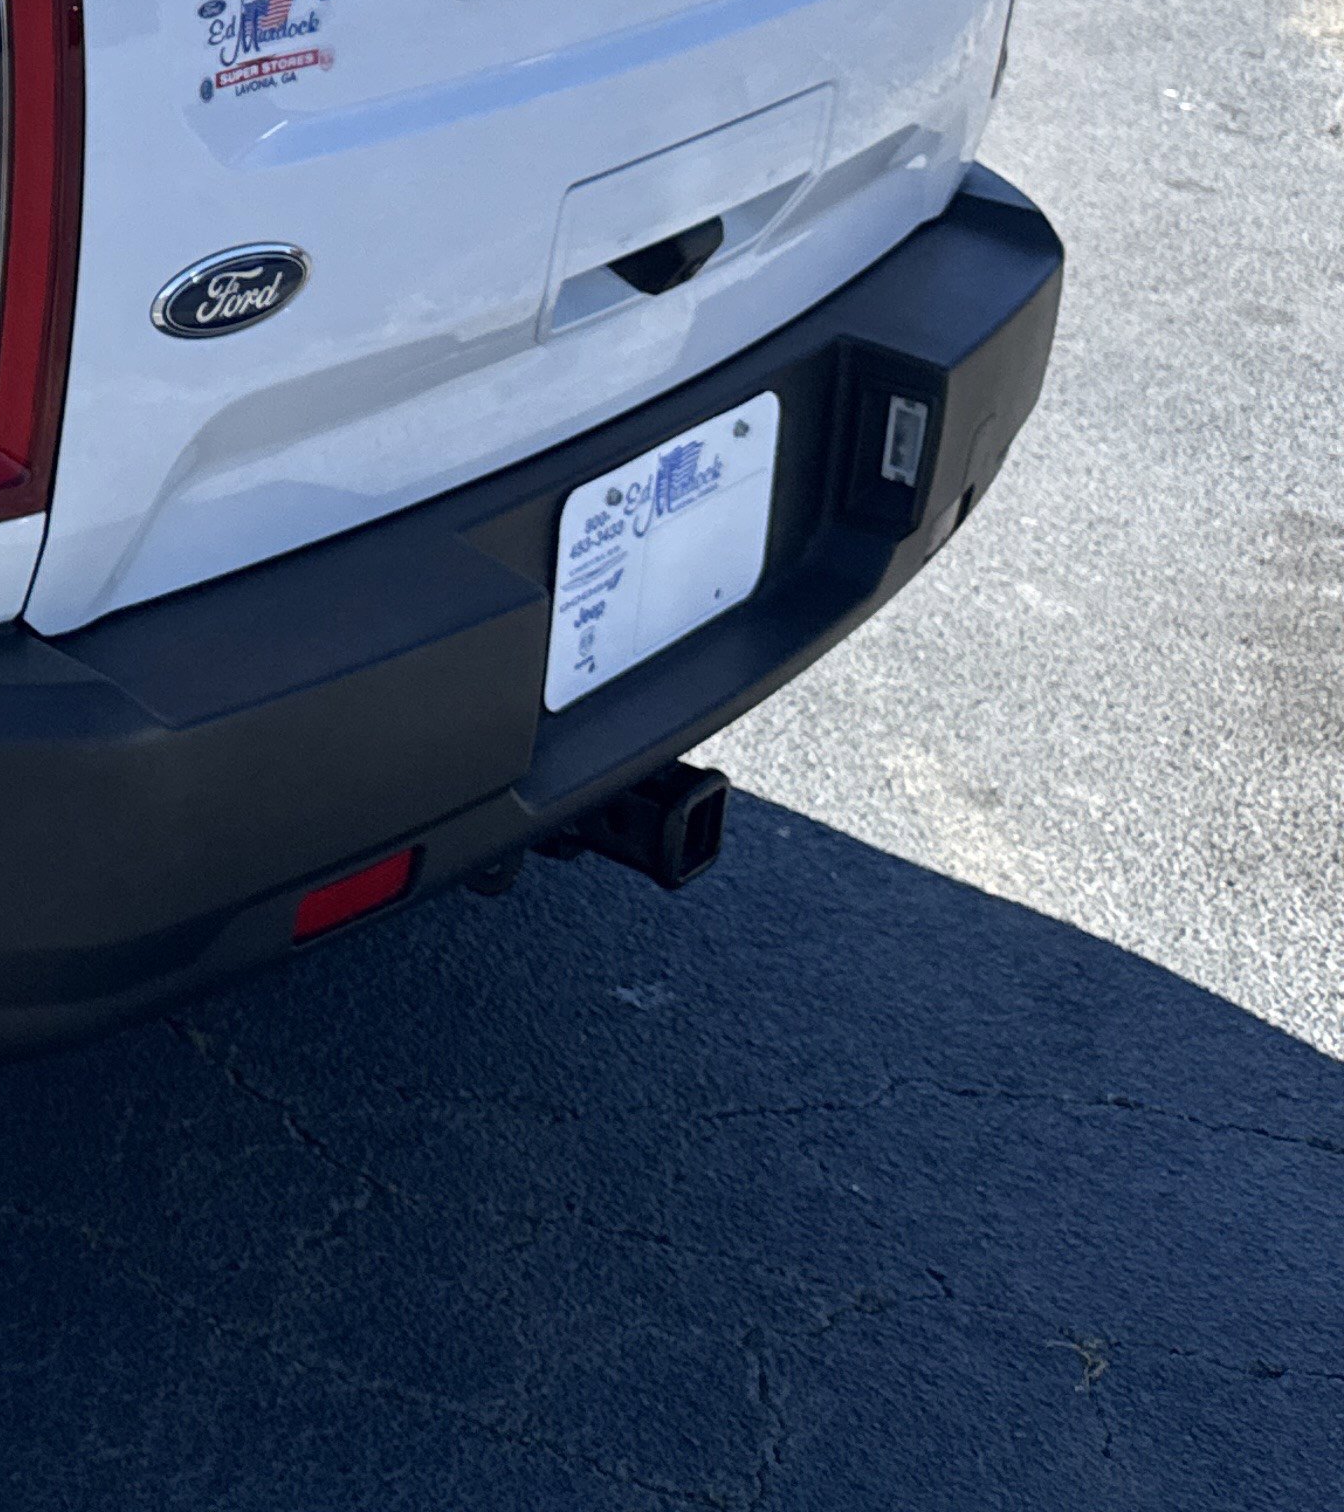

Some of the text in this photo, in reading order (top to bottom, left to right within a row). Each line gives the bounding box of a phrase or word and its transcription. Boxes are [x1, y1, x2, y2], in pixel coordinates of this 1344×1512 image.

[207, 15, 237, 46] Ed
[219, 63, 260, 87] SUPER
[261, 51, 315, 75] STORES
[196, 266, 283, 324] Ford
